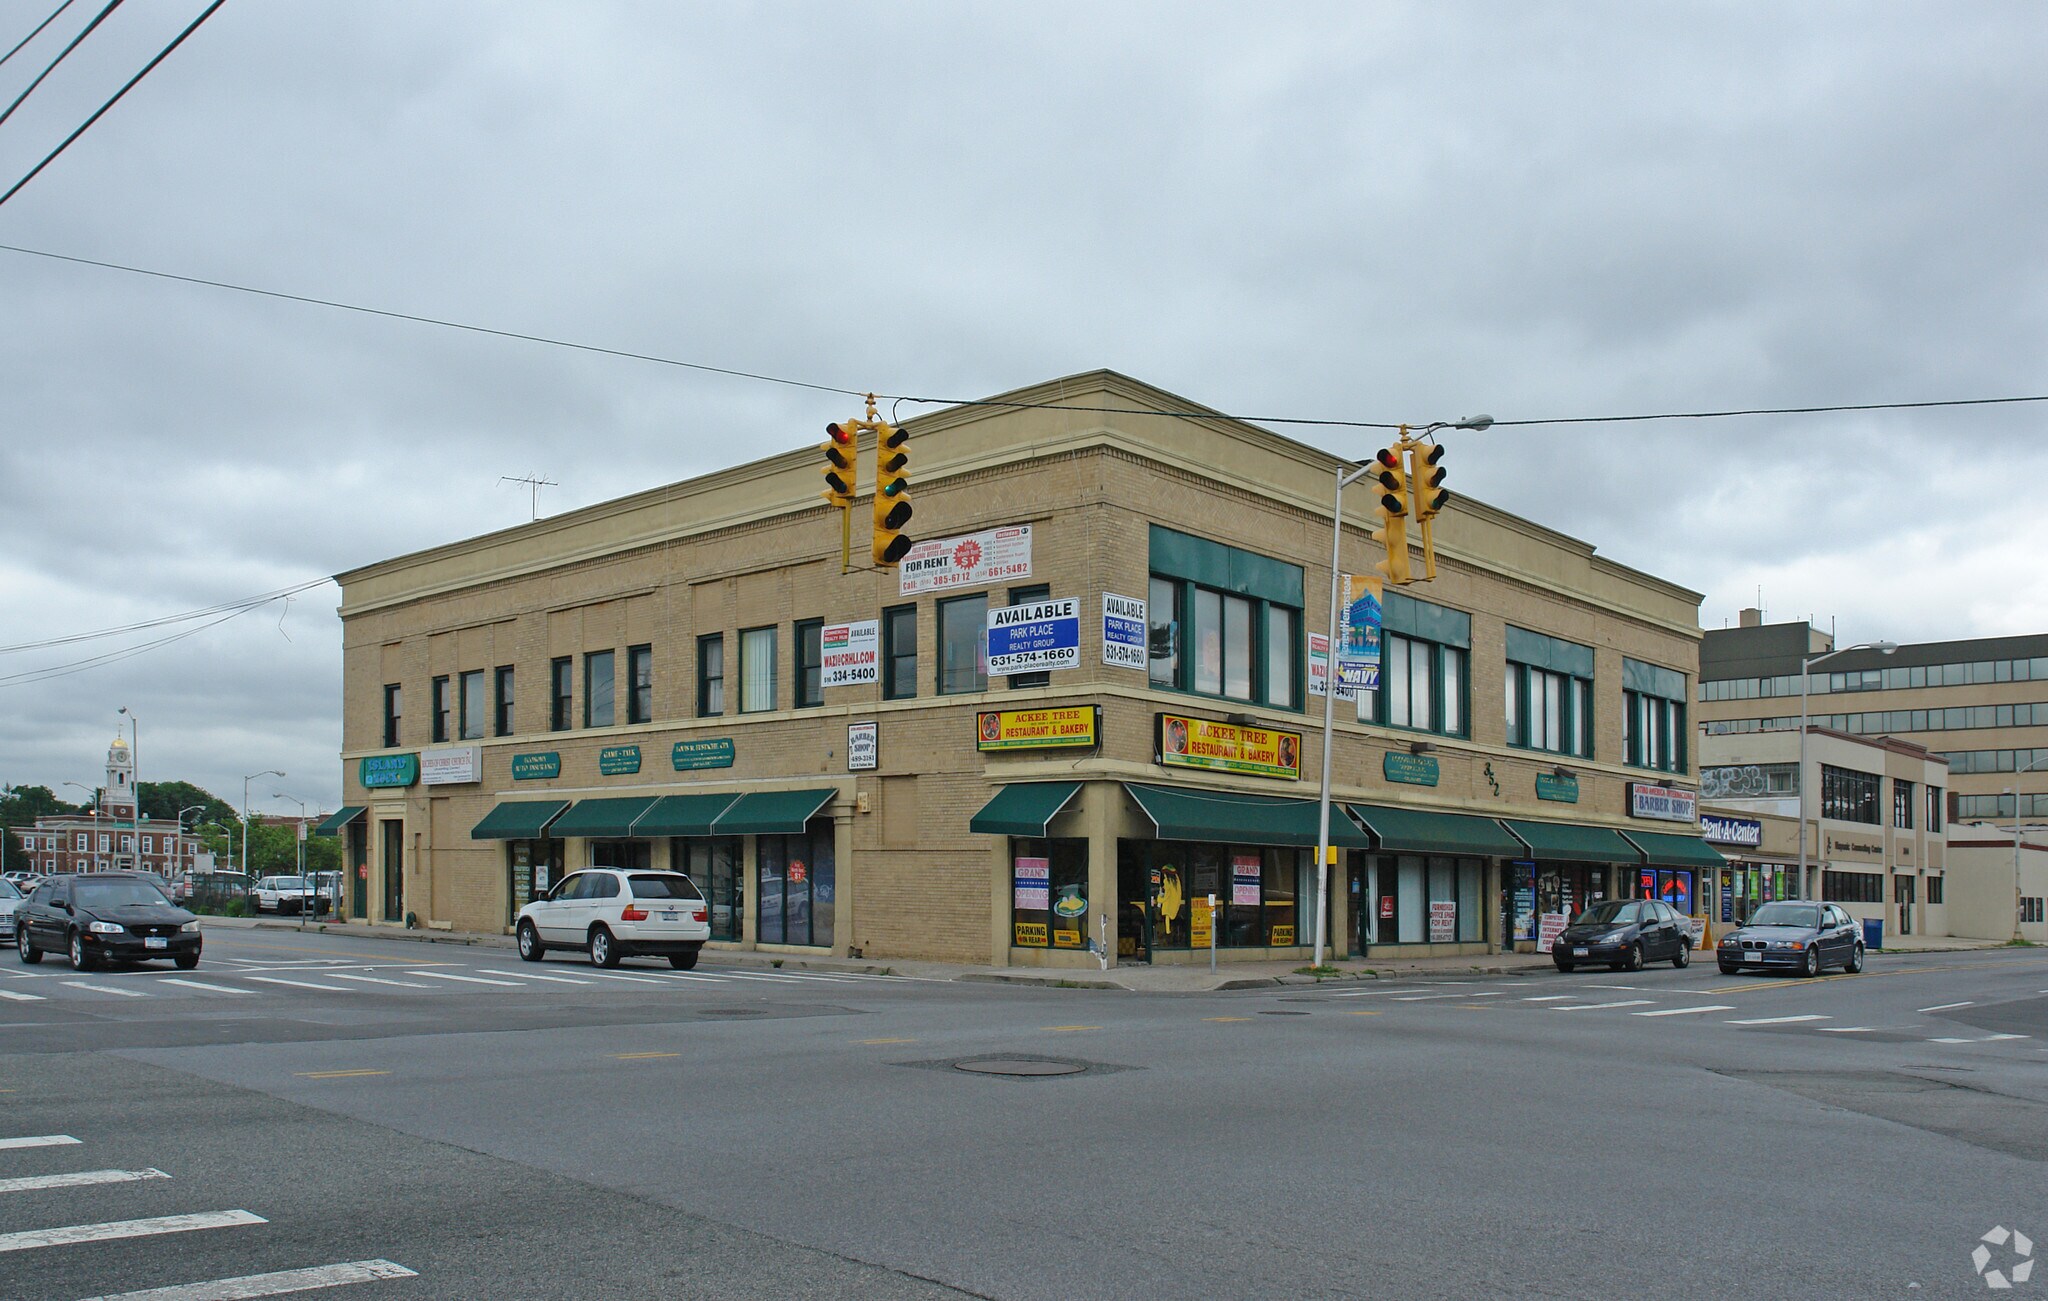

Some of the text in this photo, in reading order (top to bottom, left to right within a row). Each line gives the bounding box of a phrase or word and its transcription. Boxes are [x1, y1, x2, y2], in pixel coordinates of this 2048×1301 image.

[906, 556, 949, 572] FOR RENT
[961, 556, 975, 566] $1
[988, 563, 1028, 577] 661-5482
[903, 580, 917, 590] Call:
[933, 572, 970, 586] 385-6712
[995, 602, 1072, 625] AVAILABLE
[1106, 598, 1144, 619] AVAILABLE
[851, 628, 875, 637] AVAILABLE
[1010, 624, 1054, 639] PARK PLACE
[1108, 619, 1142, 634] PARK PLACE
[1009, 638, 1055, 651] REALTY GROUP
[1107, 632, 1143, 643] REALTY GROUP
[991, 648, 1075, 667] 631-574-1660
[1106, 644, 1145, 664] 631-574-1660
[996, 659, 1070, 673] www.park-placerealty.com
[832, 667, 875, 682] 334-5400
[1344, 669, 1379, 685] NAVY
[1015, 710, 1080, 723] ACKEE TREE
[1005, 726, 1049, 738] RESTAURANT
[1052, 725, 1057, 735] &
[1060, 723, 1089, 734] BAKERY
[1199, 725, 1236, 740] ACKEE
[1240, 729, 1268, 745] TREE
[850, 732, 875, 745] BARBER
[854, 744, 870, 752] SHOP
[1191, 741, 1238, 759] RESTAURANT
[1240, 749, 1245, 758] &
[1248, 750, 1275, 763] BAKERY
[367, 757, 407, 771] ISLAND
[1484, 762, 1500, 796] 352
[1639, 795, 1690, 815] BARBER SHOP
[794, 872, 801, 880] $1
[1018, 868, 1046, 877] GRAND
[1237, 866, 1258, 875] GRAND
[1015, 889, 1048, 899] OPENING
[1017, 925, 1046, 936] PARKING
[1273, 927, 1293, 937] PARKING
